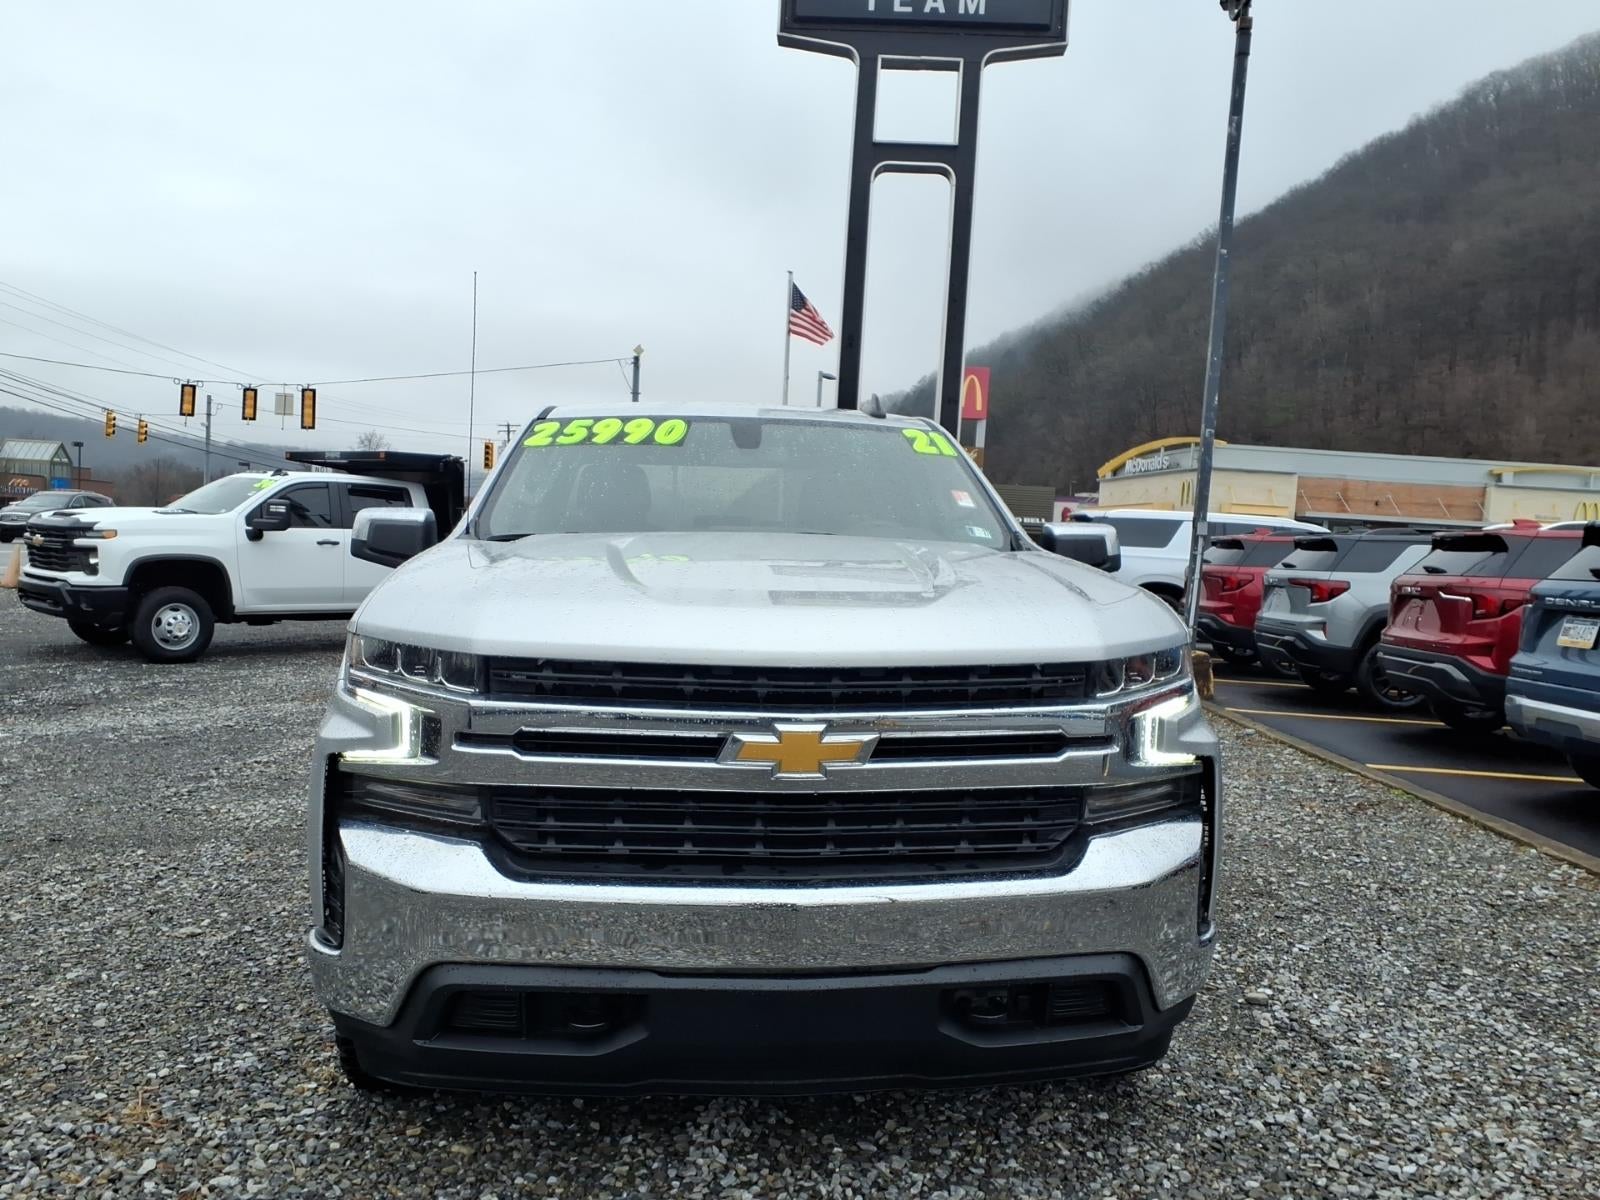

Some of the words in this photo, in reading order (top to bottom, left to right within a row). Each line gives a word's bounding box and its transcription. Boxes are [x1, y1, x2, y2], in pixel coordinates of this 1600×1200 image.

[523, 417, 688, 446] 25990
[902, 428, 958, 457] 21
[1125, 456, 1170, 474] McDonald's
[1544, 597, 1600, 608] DENAL
